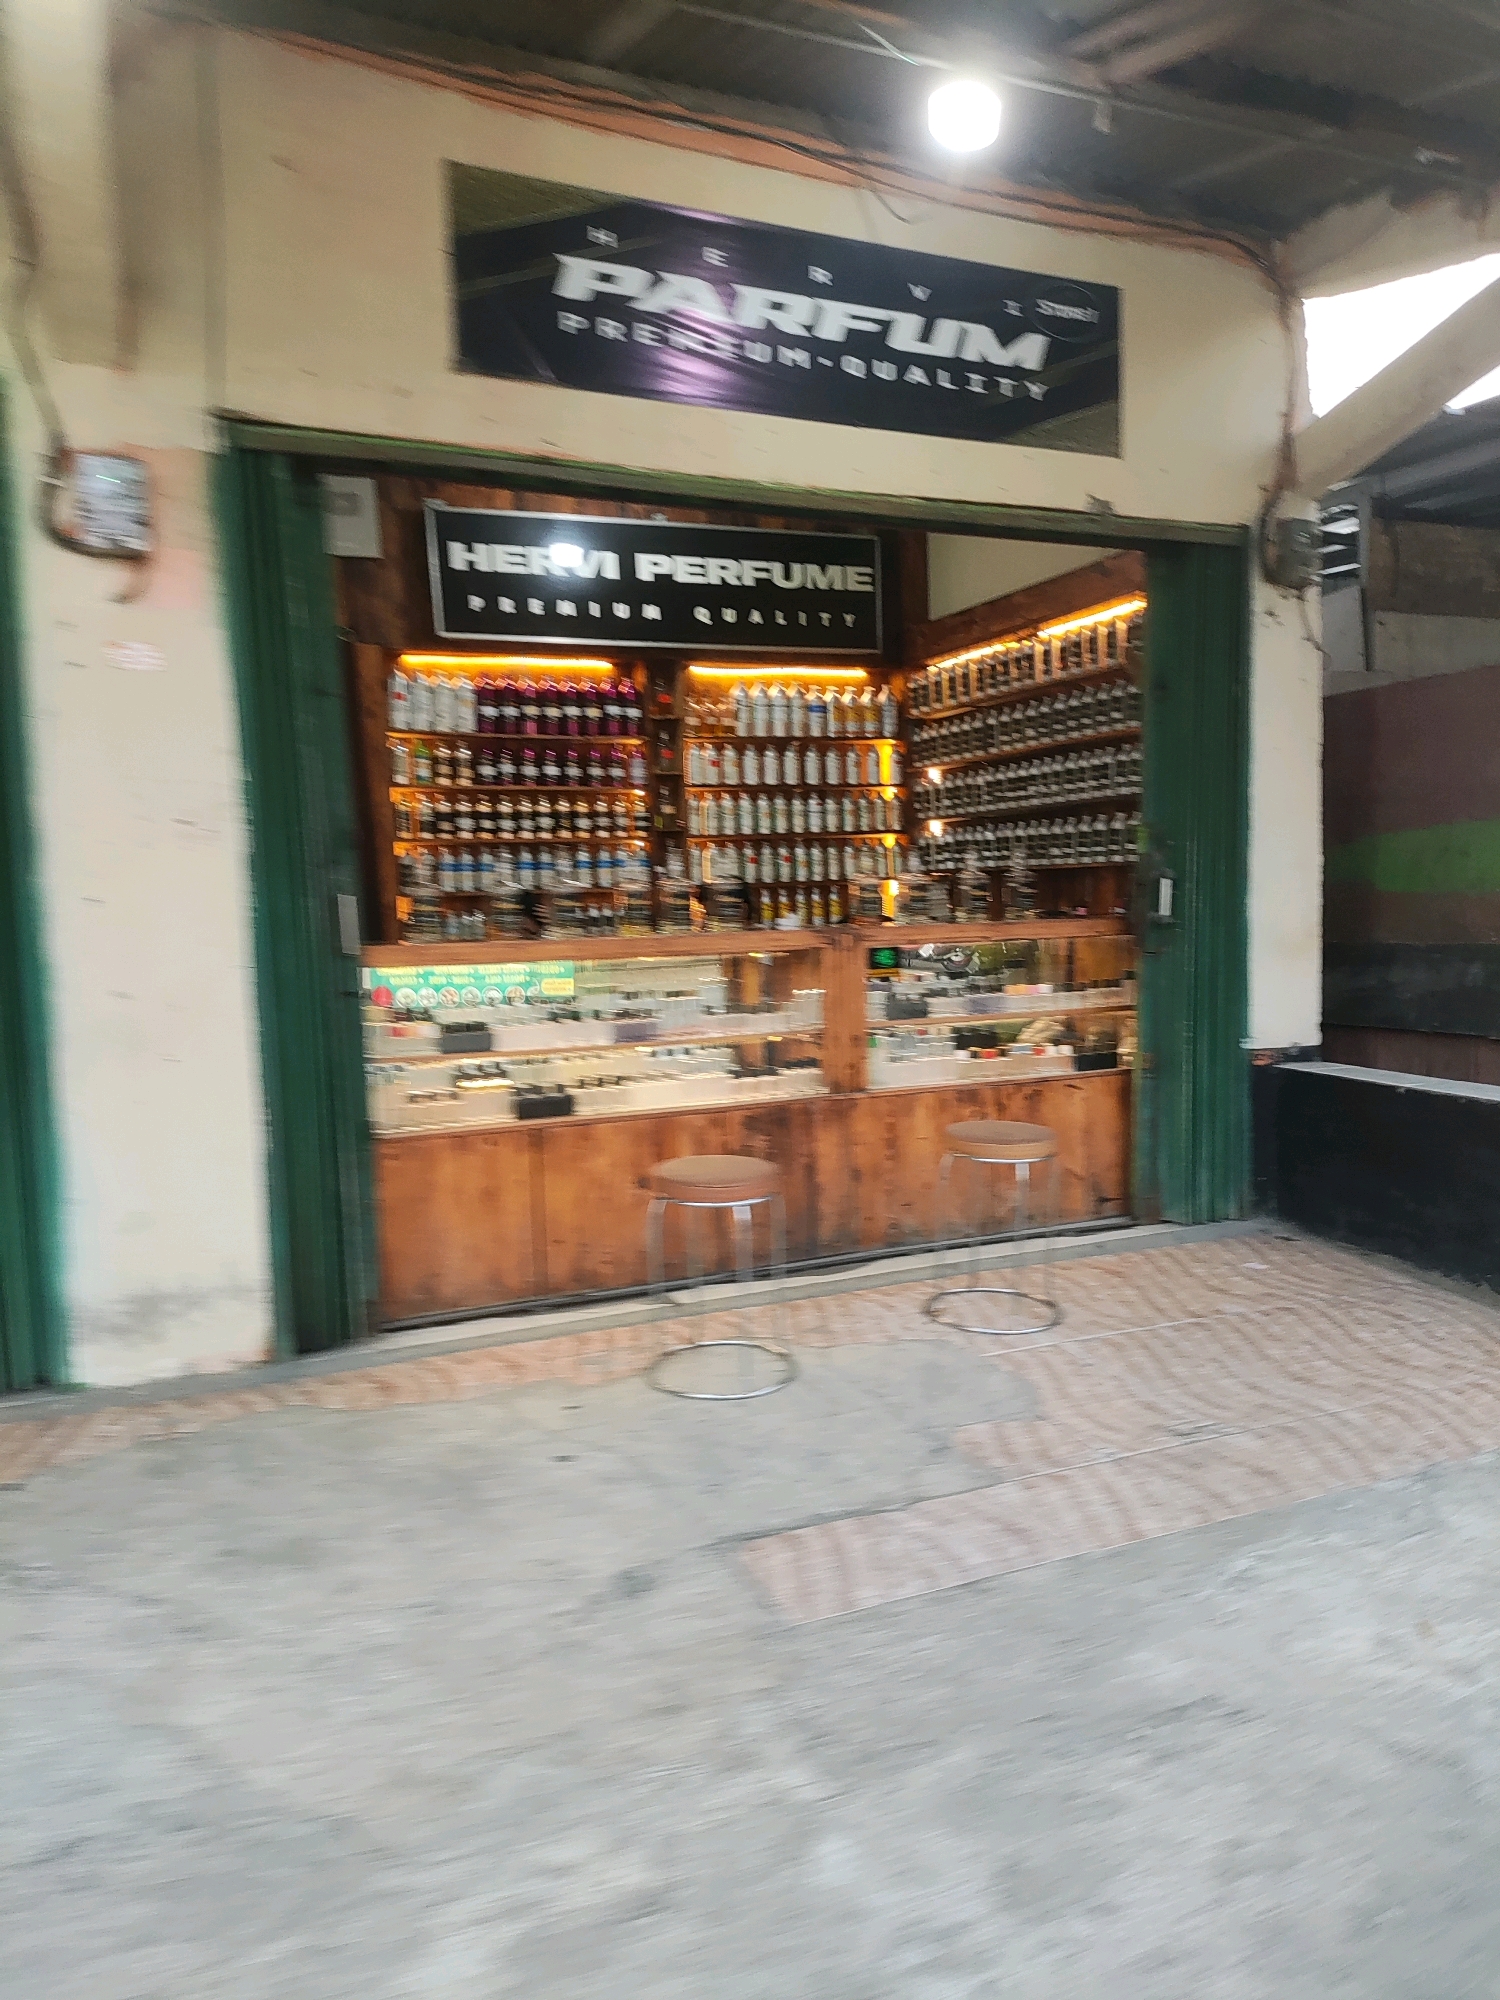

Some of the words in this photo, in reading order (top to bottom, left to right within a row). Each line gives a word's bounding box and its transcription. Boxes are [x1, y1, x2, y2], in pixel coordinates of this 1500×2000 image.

[551, 252, 1051, 372] PARFUM
[633, 552, 875, 593] PERFUME
[467, 594, 663, 621] PREMIUM
[693, 606, 856, 628] QUALITY
